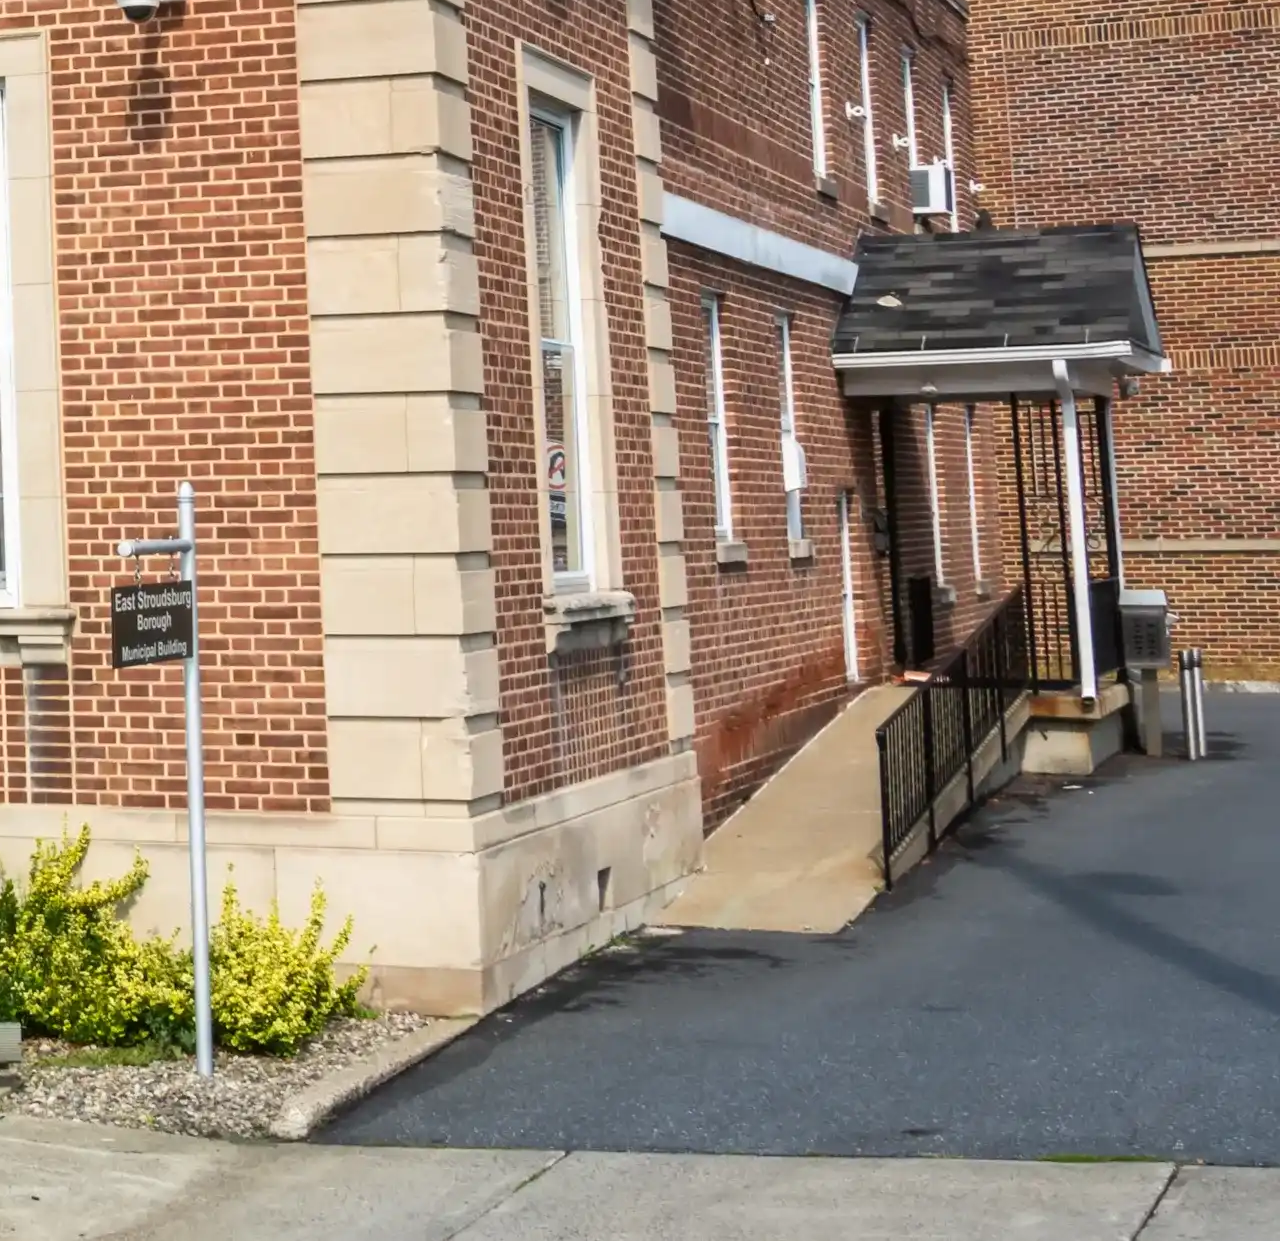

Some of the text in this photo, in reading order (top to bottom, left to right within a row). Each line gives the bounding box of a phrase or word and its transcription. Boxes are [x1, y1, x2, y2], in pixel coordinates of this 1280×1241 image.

[115, 588, 191, 612] East Stroudsburg
[137, 611, 172, 632] Borough
[122, 639, 187, 661] Municipal Building
